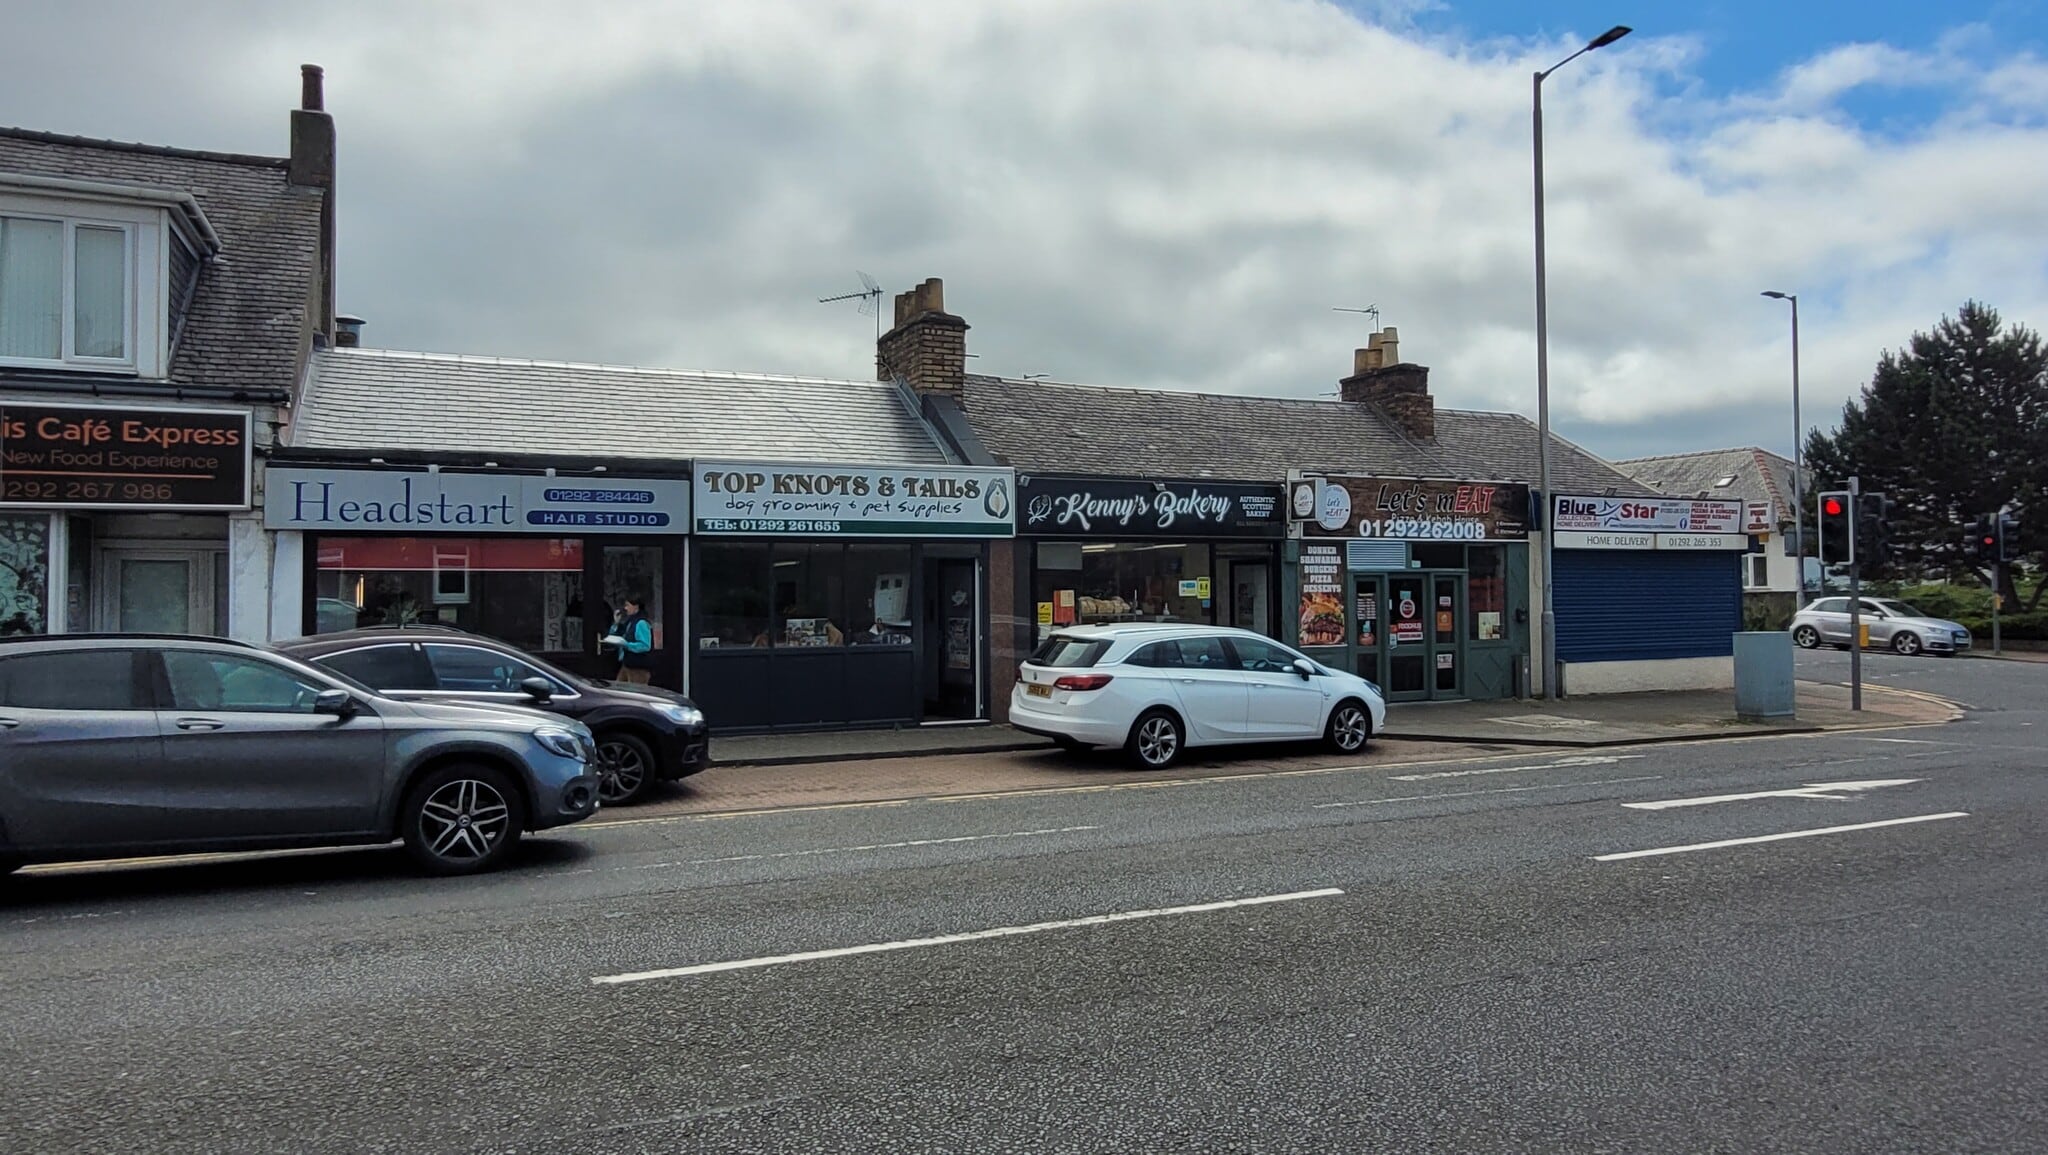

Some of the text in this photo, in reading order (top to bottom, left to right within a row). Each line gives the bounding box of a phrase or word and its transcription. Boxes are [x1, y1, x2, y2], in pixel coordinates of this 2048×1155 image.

[38, 417, 112, 446] Café
[123, 420, 240, 448] Express
[51, 449, 103, 466] Food
[109, 451, 218, 469] Experience
[66, 482, 115, 499] 267
[123, 483, 172, 499] 986
[703, 472, 981, 499] TOP KNOTS & TAILS
[289, 477, 514, 525] Headstart
[550, 490, 649, 502] 01292 284446
[1239, 496, 1276, 504] AUTHENTIC
[1376, 483, 1496, 514] Let's mEAT
[725, 494, 756, 516] dog
[762, 499, 840, 517] grooming
[863, 500, 891, 518] pet
[898, 500, 962, 518] supplies
[1054, 489, 1231, 531] Kenny's Bakery
[1559, 499, 1659, 519] Blue Star
[544, 513, 658, 525] HAIR STUDIO
[1246, 510, 1270, 518] BAKERY
[704, 519, 841, 532] TEL: 01292 261655
[1587, 535, 1649, 546] HOME DELIVERY
[1669, 537, 1722, 547] 01292 265 353
[1304, 565, 1337, 573] BURGERS
[1310, 575, 1332, 583] PIZZA
